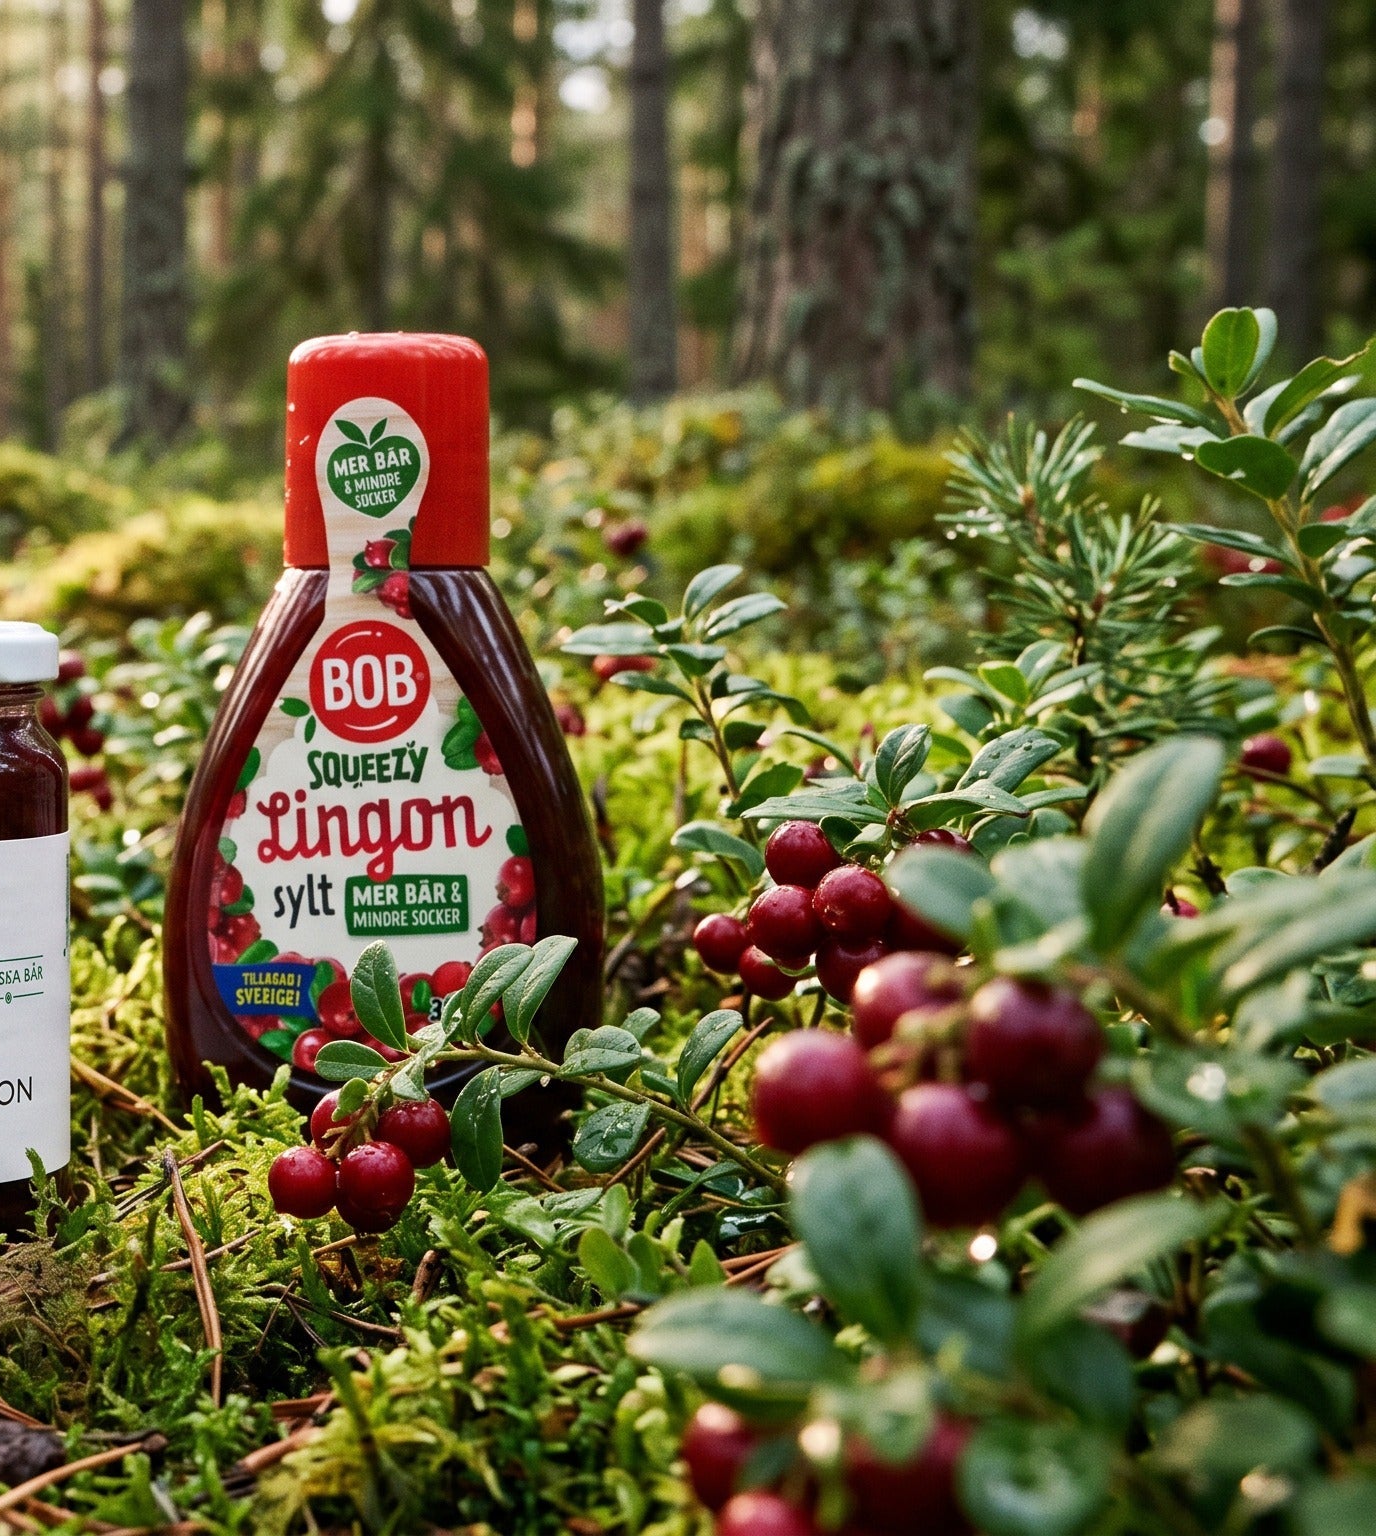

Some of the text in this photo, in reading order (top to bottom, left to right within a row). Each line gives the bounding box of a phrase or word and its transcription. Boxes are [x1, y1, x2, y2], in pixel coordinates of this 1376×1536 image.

[333, 446, 412, 479] MER BÄR
[344, 471, 402, 495] & MINDRE
[355, 488, 397, 509] SOCKER
[322, 653, 417, 711] BOB
[307, 745, 429, 790] SQUEEZY
[256, 786, 492, 883] Lingon
[274, 873, 335, 929] sylt
[352, 879, 462, 907] MER BÄR &
[353, 908, 461, 928] MINDRE SOCKER
